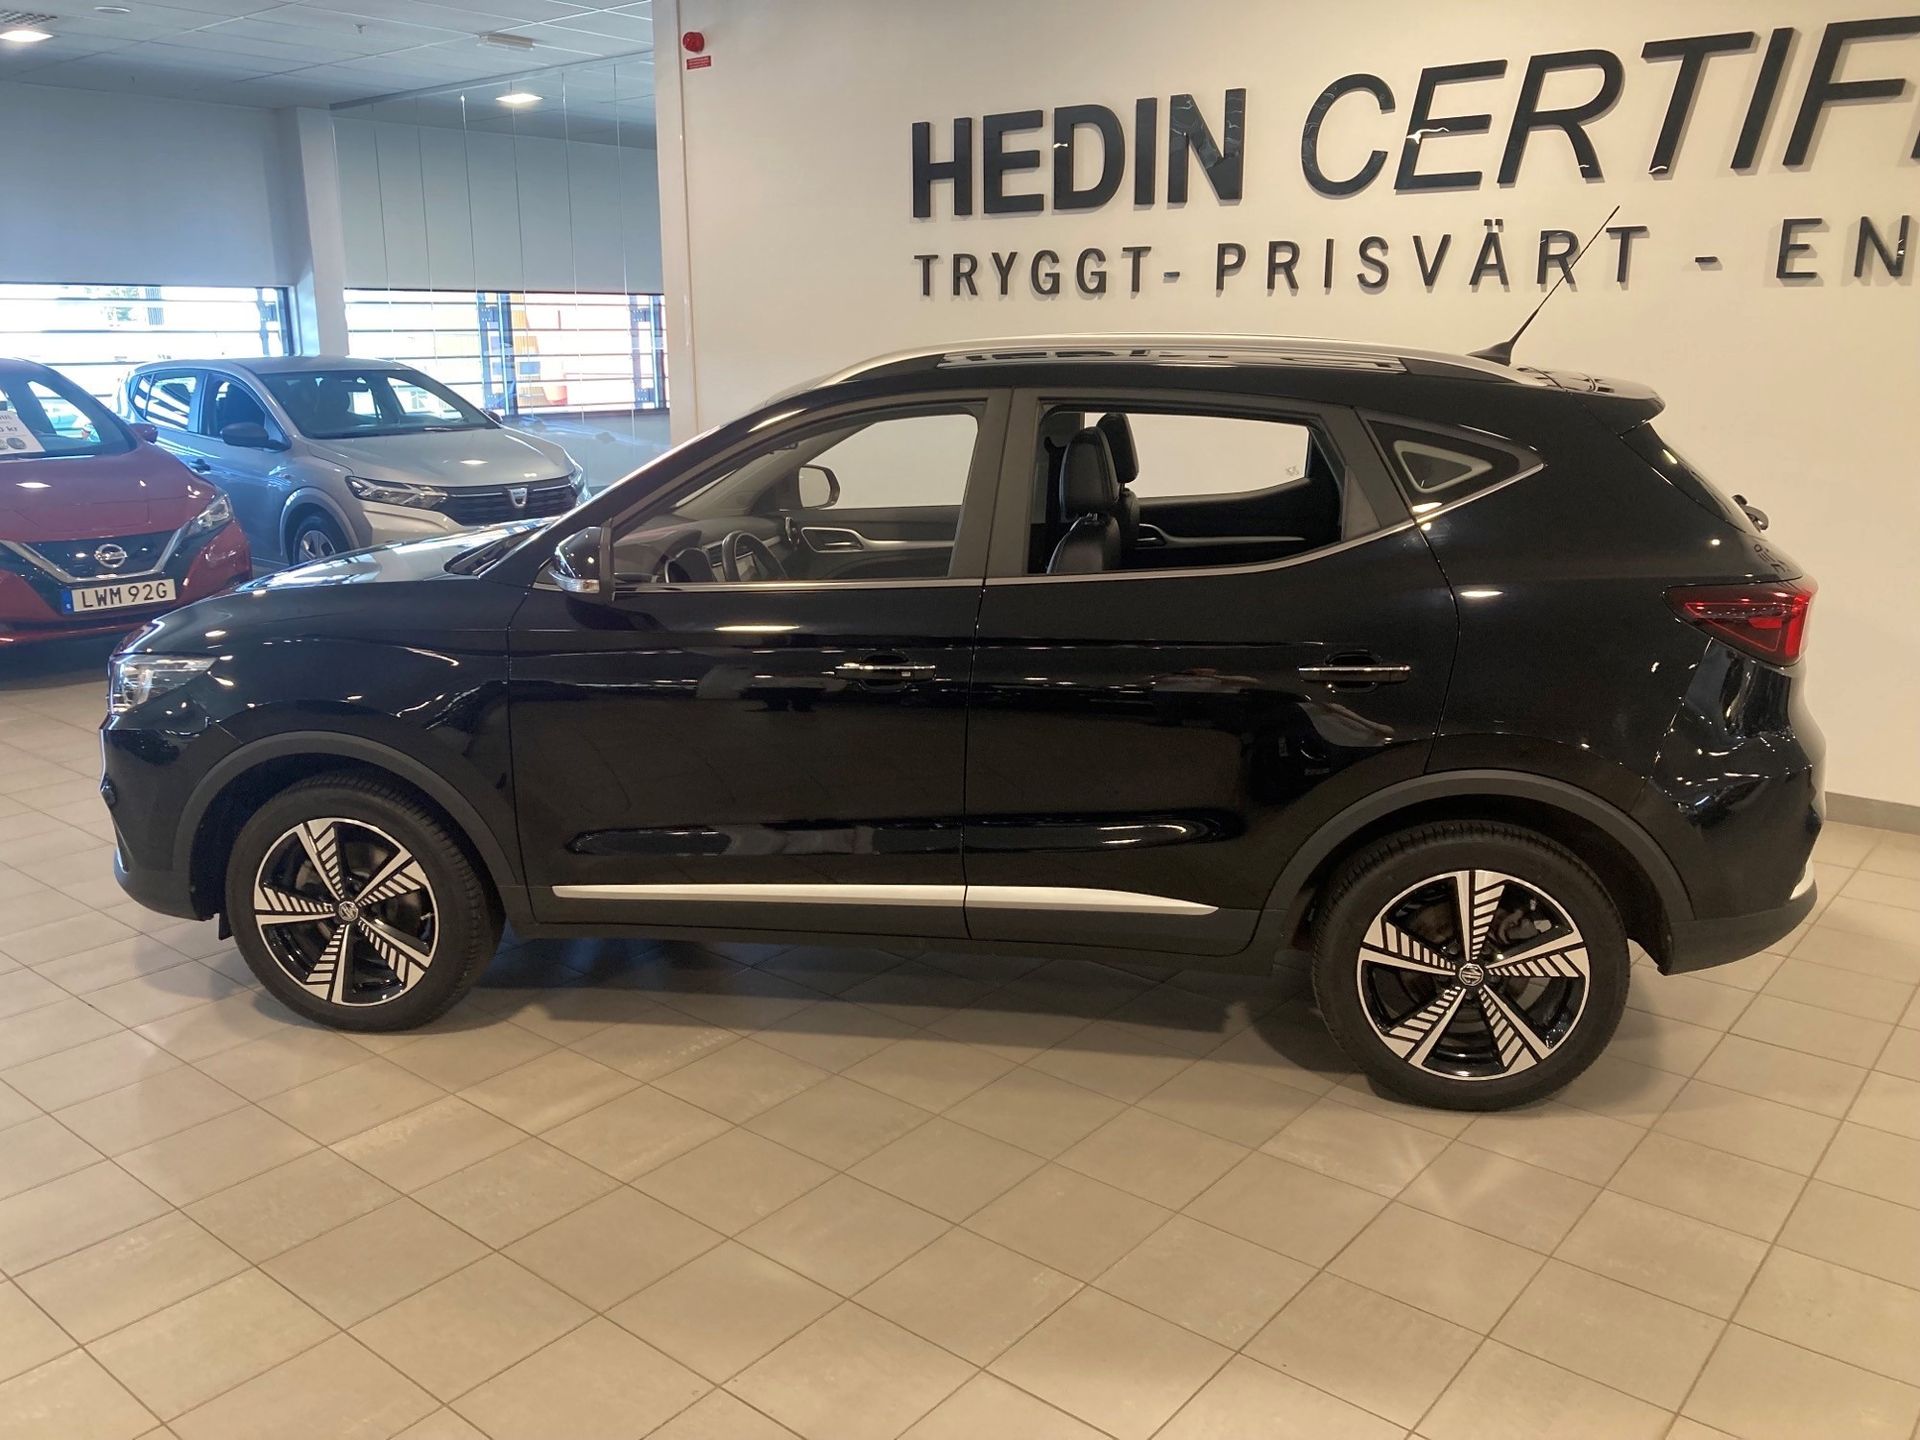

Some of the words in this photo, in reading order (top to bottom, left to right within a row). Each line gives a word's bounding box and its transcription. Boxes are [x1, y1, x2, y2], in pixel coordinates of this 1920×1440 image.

[911, 88, 1246, 218] HEDIN
[1301, 15, 1920, 199] CERTIF
[1216, 218, 1650, 290] PRISVÄRT
[1776, 214, 1910, 279] EN
[81, 587, 122, 608] LWM
[128, 582, 168, 603] 92G
